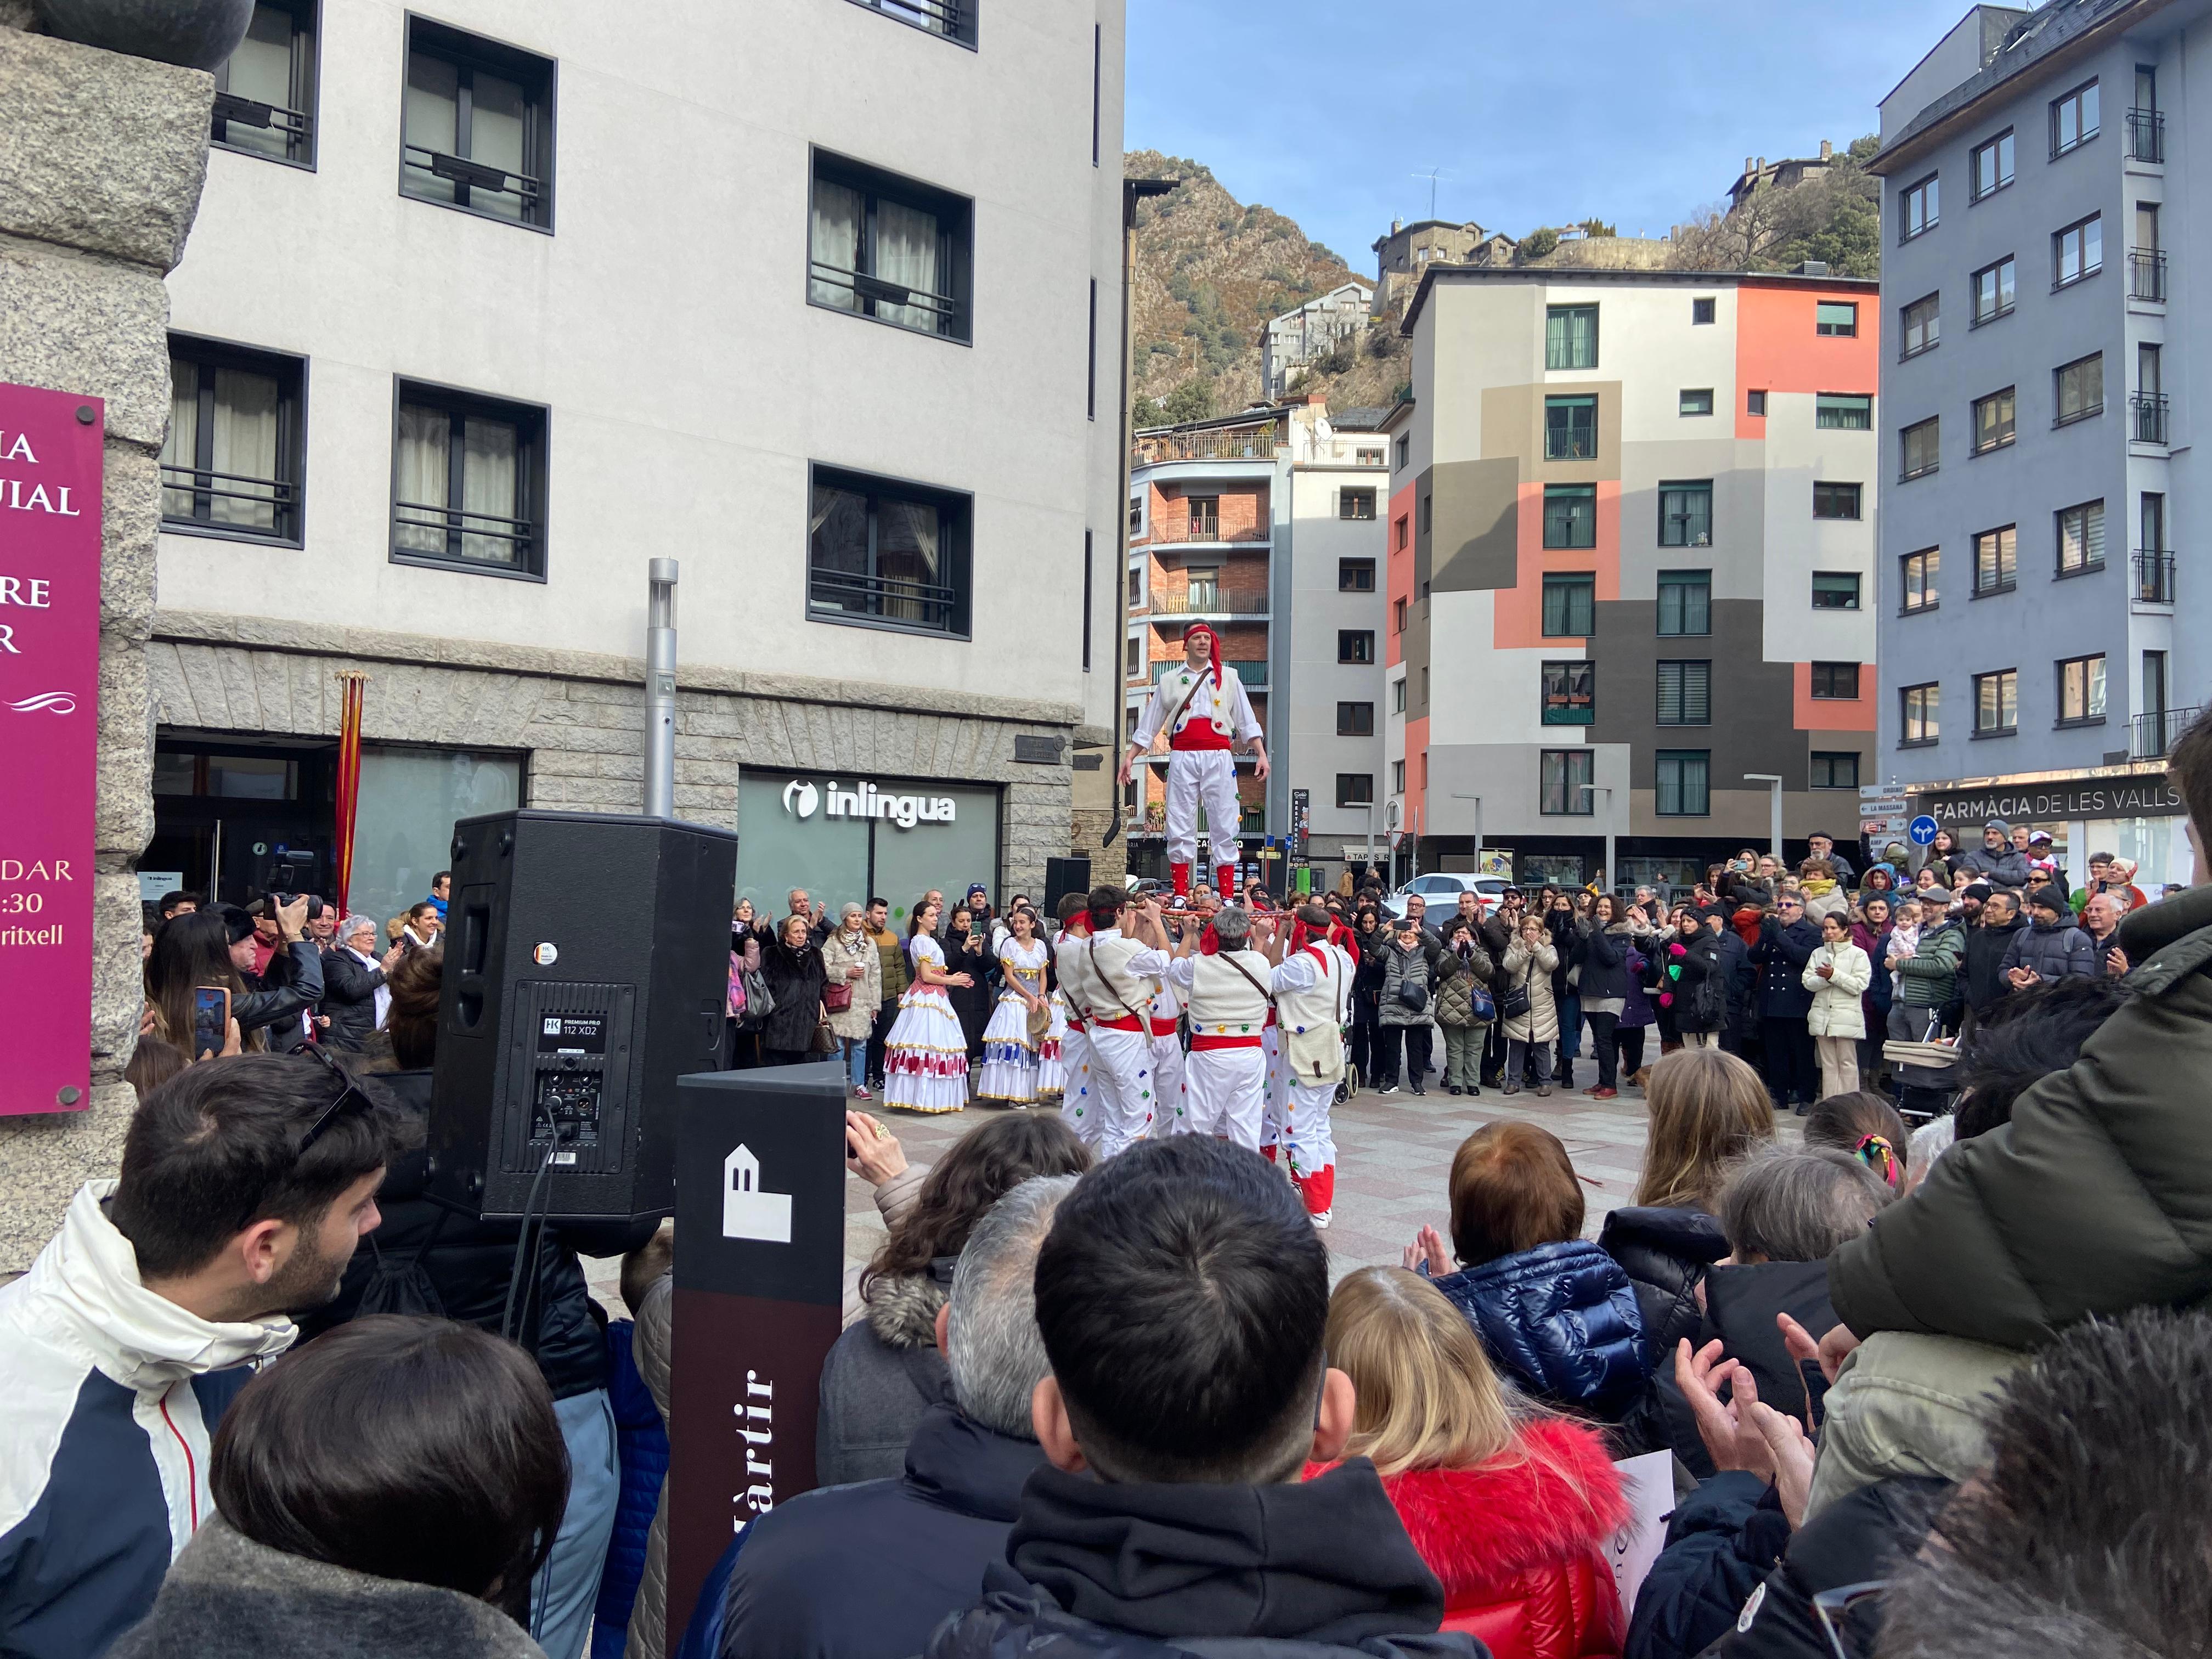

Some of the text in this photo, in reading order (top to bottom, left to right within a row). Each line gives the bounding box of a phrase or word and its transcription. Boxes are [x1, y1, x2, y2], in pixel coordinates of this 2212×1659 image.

[827, 781, 956, 828] inlingua
[1933, 786, 2181, 820] FARMÀCIA DE LES VALLS
[1, 860, 74, 881] DAR
[1, 924, 63, 945] ritxell
[546, 1020, 559, 1029] HK
[564, 1026, 597, 1035] 112 XD2
